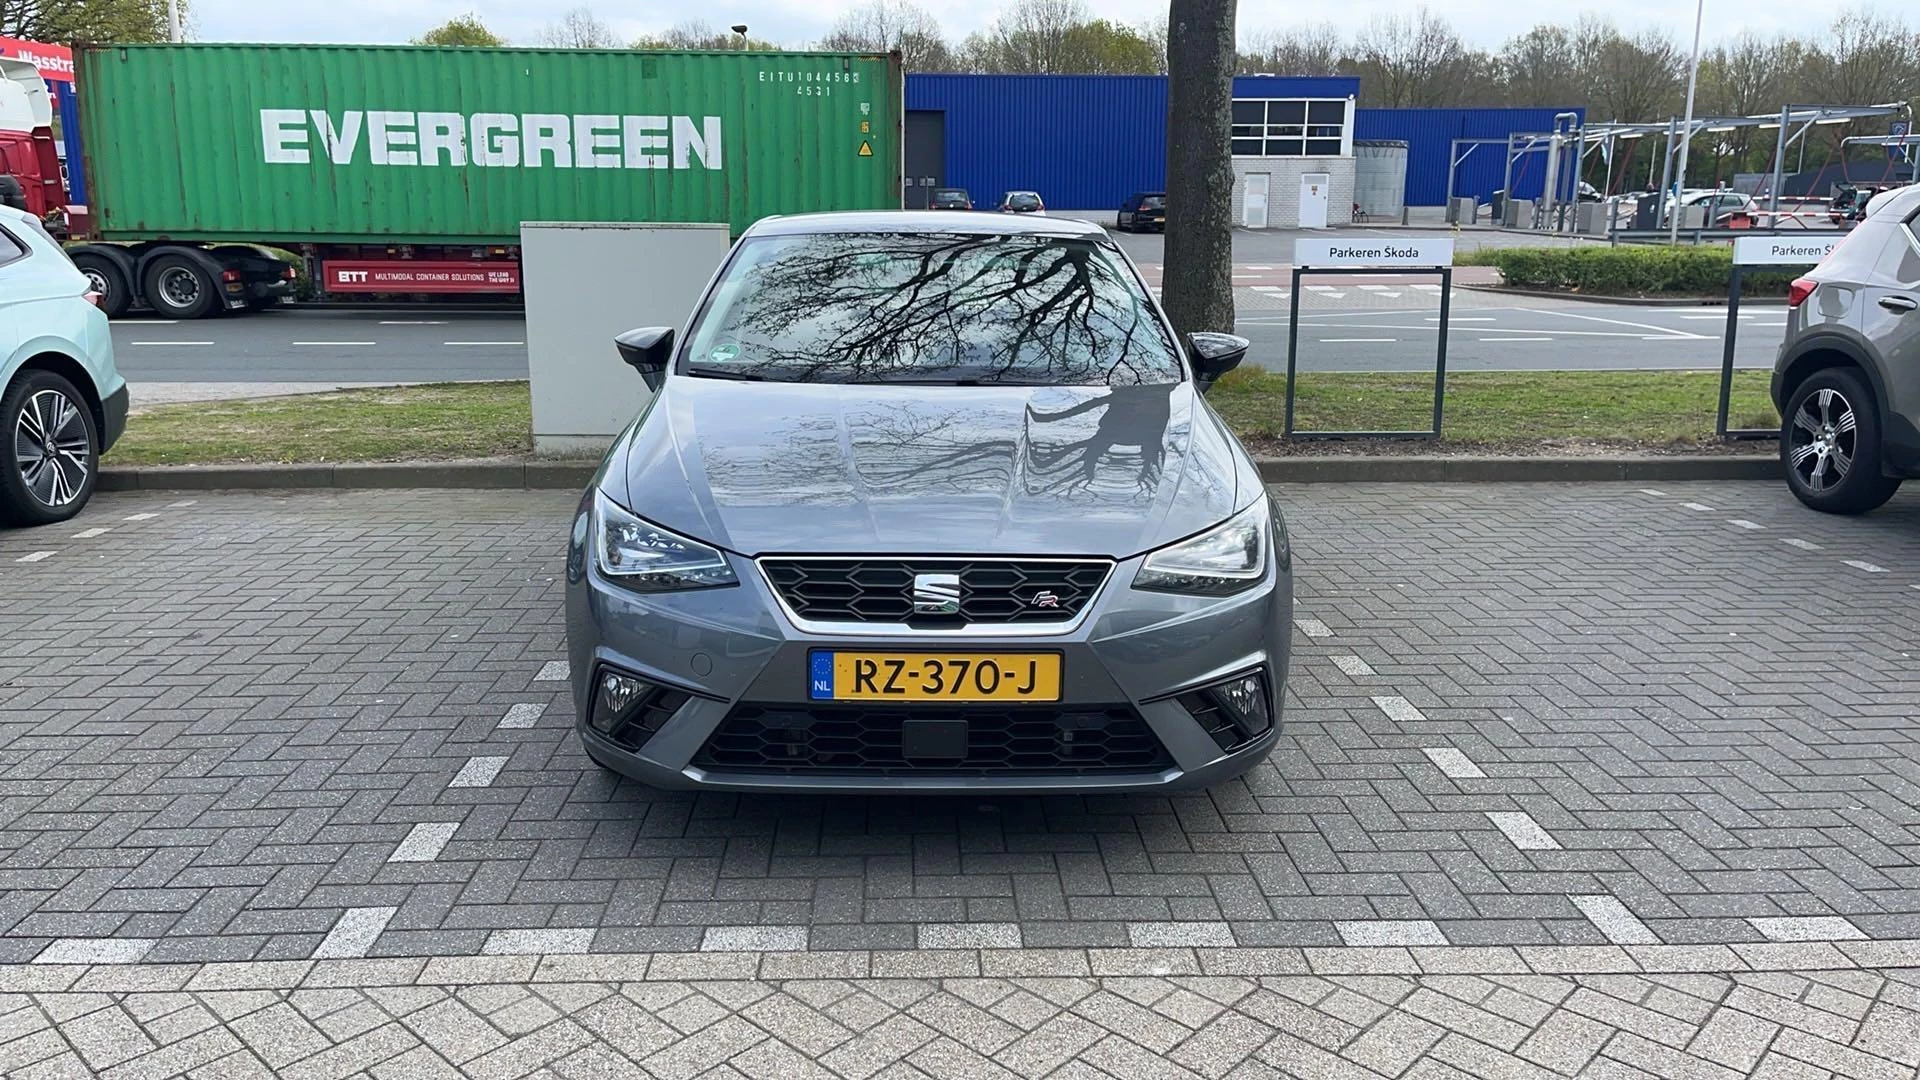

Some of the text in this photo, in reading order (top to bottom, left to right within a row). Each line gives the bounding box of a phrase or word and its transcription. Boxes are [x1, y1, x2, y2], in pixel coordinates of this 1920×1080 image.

[260, 109, 723, 170] EVERGREEN
[1329, 245, 1419, 258] Parkeren Škoda
[1771, 245, 1821, 256] Parkeren
[375, 272, 485, 281] MULTIMODAL CONTAINER SOLUTIONS
[1031, 590, 1059, 608] FR
[855, 659, 1036, 694] RZ-370-J
[814, 680, 831, 691] NL
